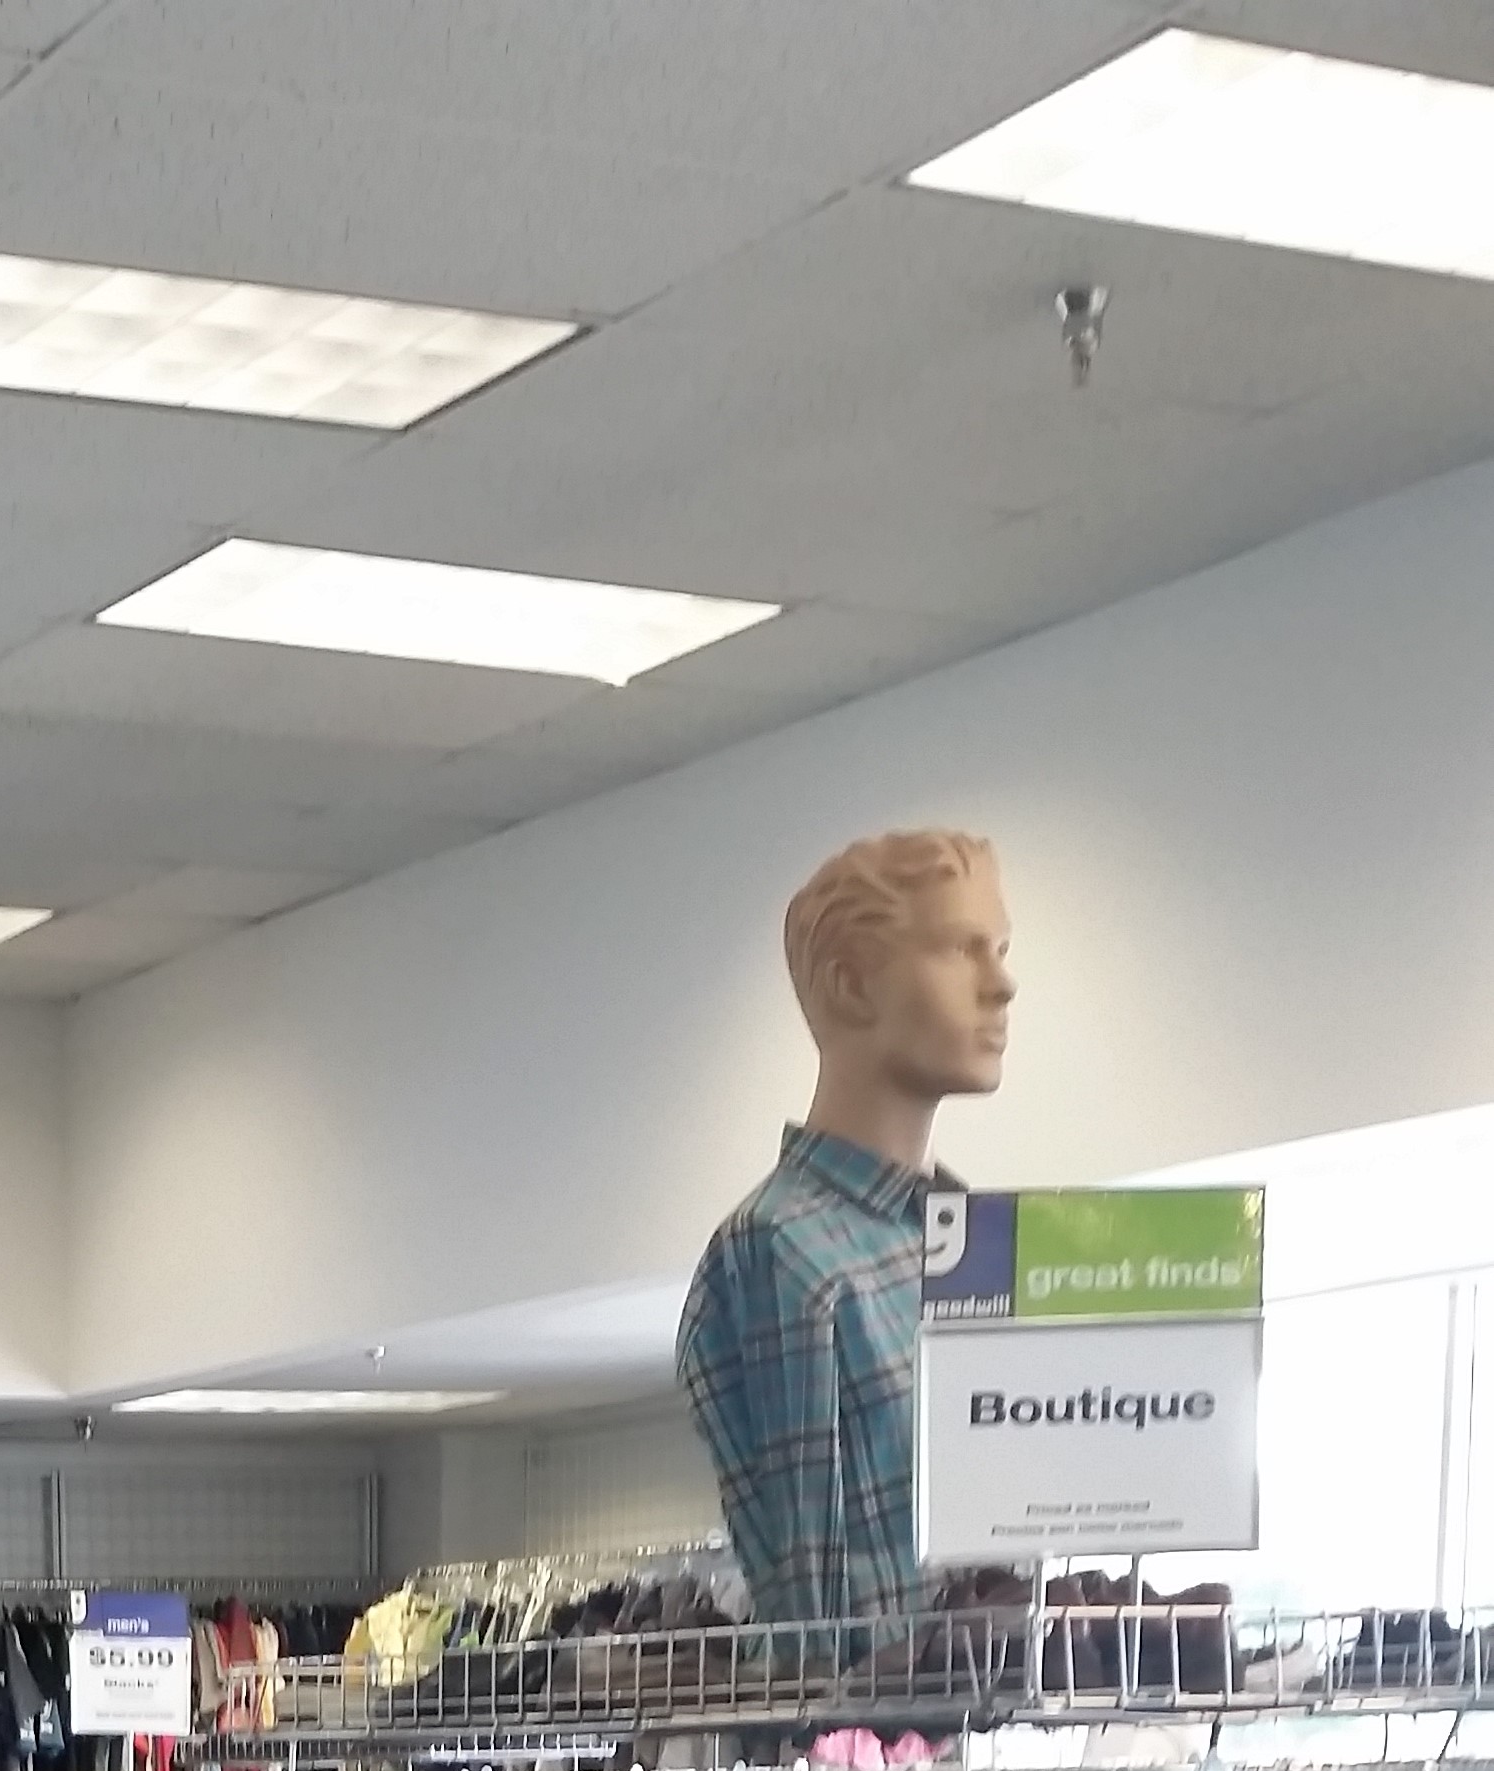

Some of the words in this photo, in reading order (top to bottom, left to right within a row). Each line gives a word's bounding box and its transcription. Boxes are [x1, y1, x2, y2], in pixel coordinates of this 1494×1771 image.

[1026, 1257, 1134, 1300] great
[1146, 1255, 1243, 1289] finds
[968, 1385, 1217, 1432] Boutique
[107, 1616, 150, 1634] men's
